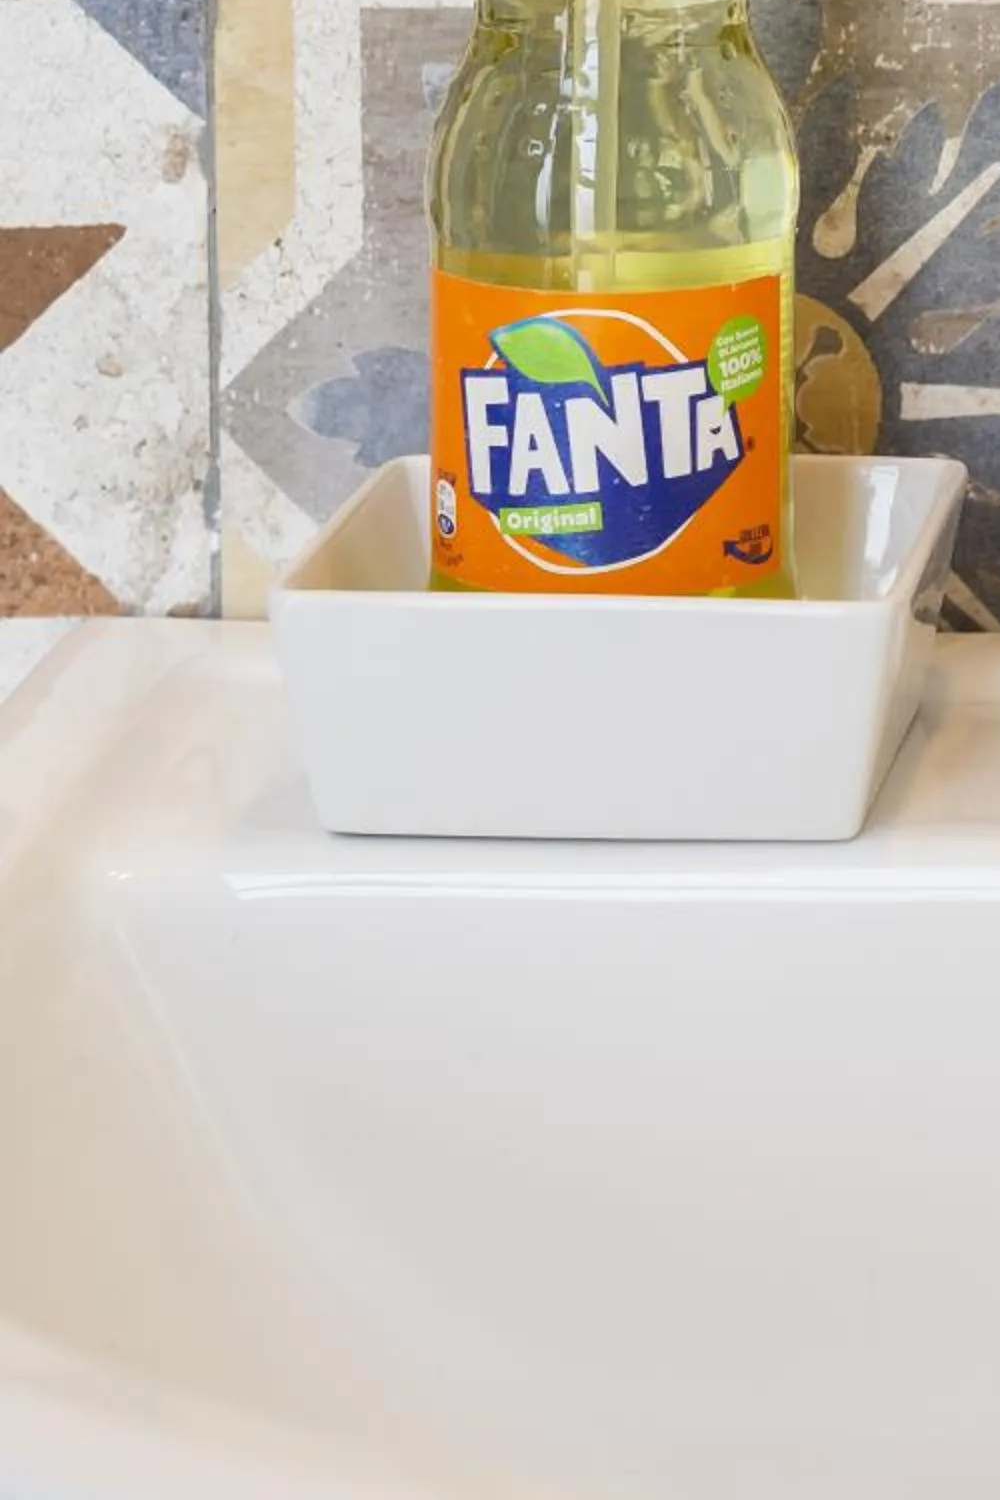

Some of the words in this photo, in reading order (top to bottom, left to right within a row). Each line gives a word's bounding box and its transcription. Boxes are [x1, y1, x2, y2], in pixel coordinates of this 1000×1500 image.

[718, 347, 763, 379] 100%
[464, 366, 742, 496] FANTA
[507, 507, 597, 534] Original
